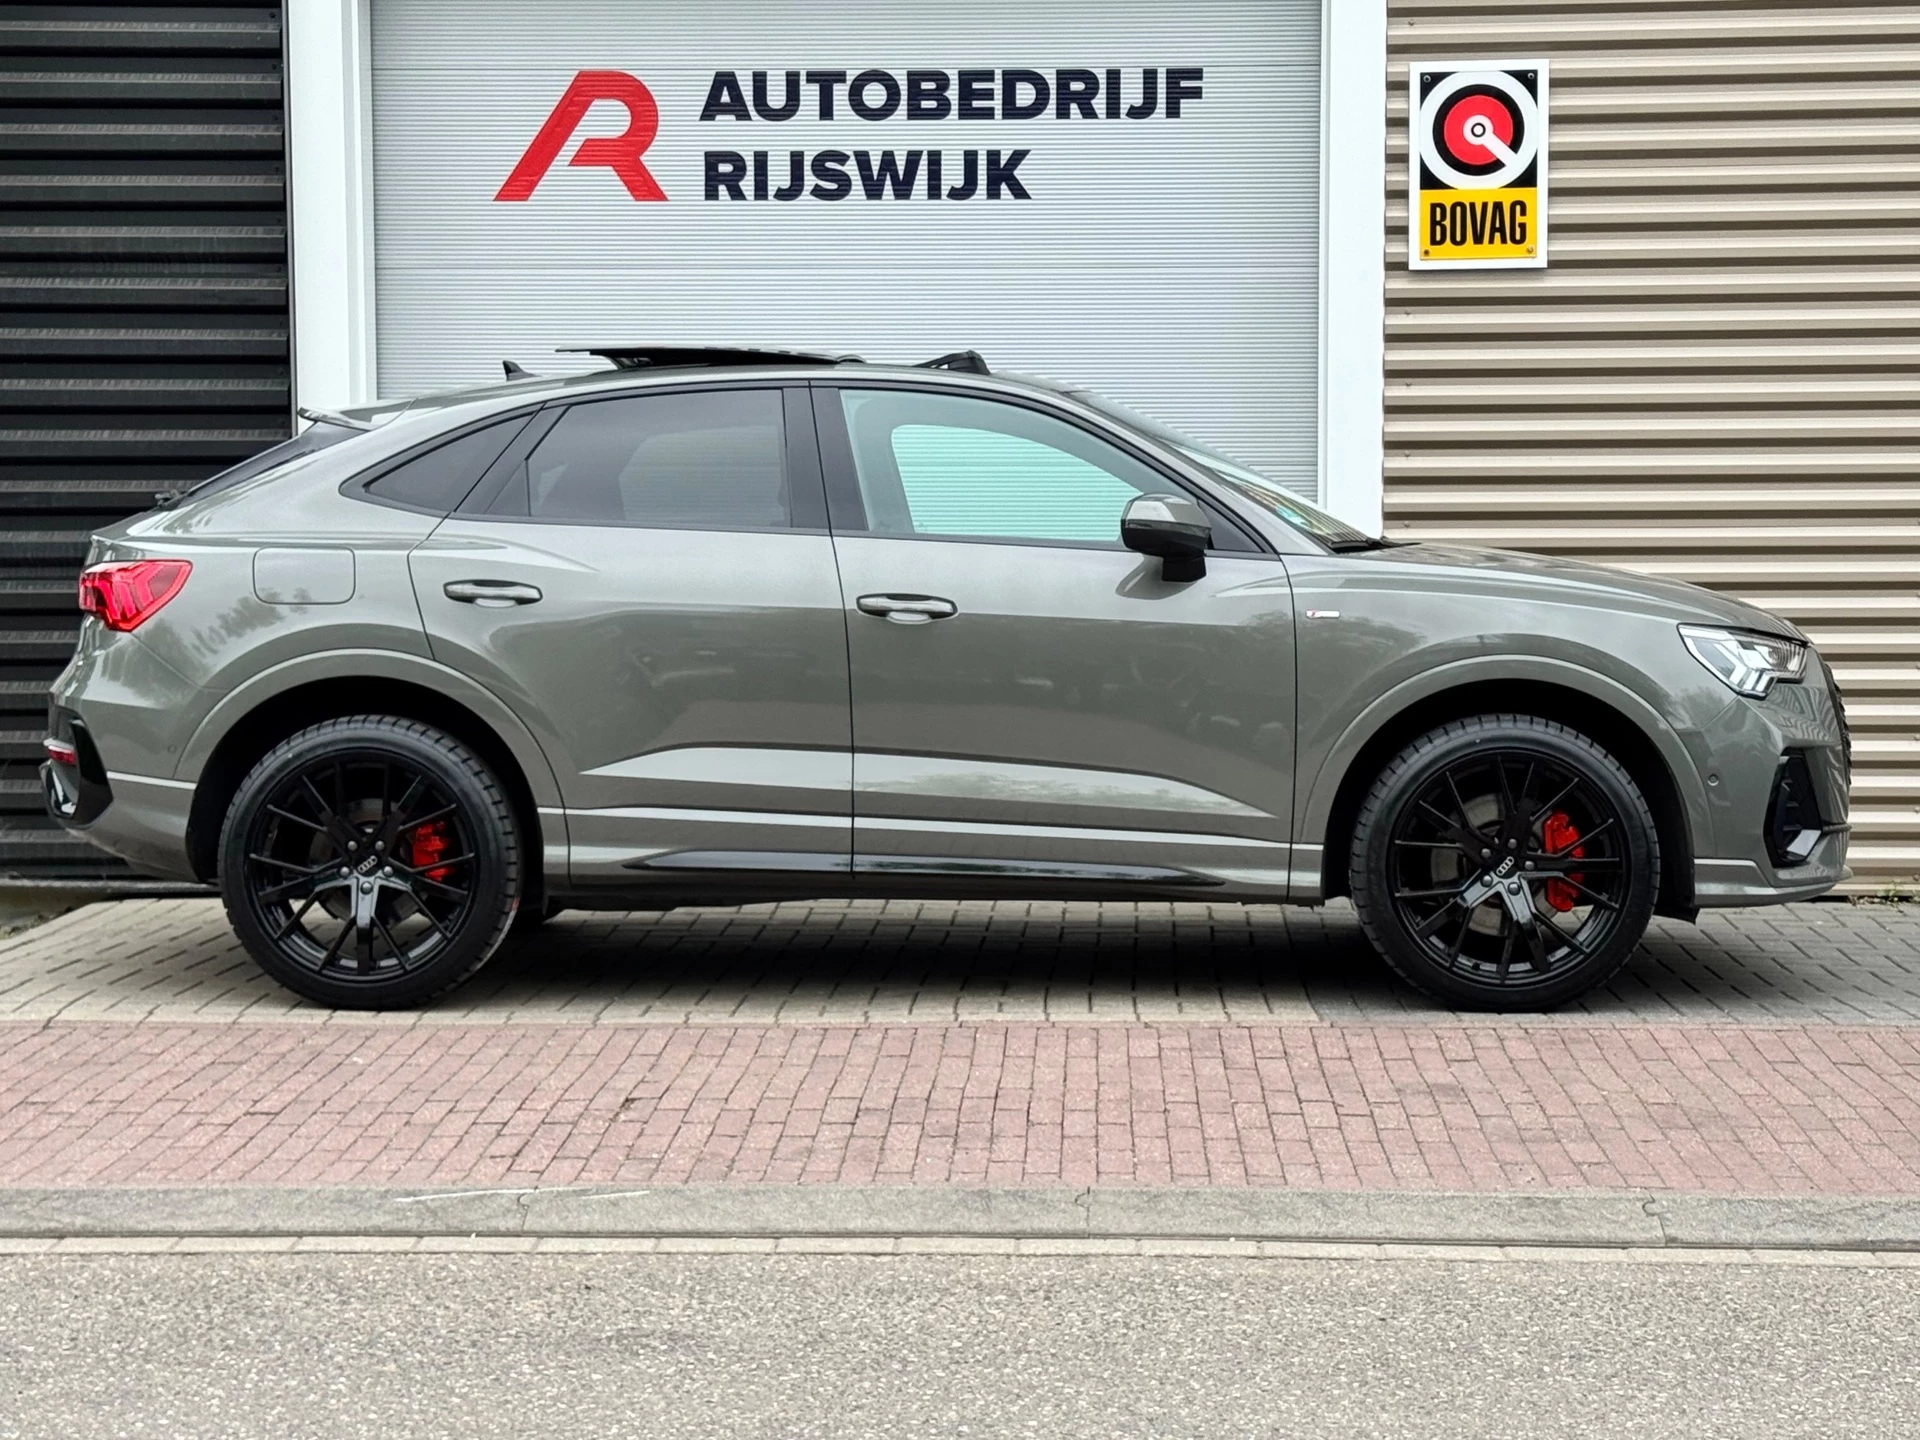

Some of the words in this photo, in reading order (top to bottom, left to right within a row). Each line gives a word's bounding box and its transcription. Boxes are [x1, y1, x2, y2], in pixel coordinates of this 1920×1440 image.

[700, 68, 1203, 121] AUTOBEDRIJF
[705, 150, 1031, 201] RIJSWIJK
[1430, 200, 1526, 246] BOVAG
